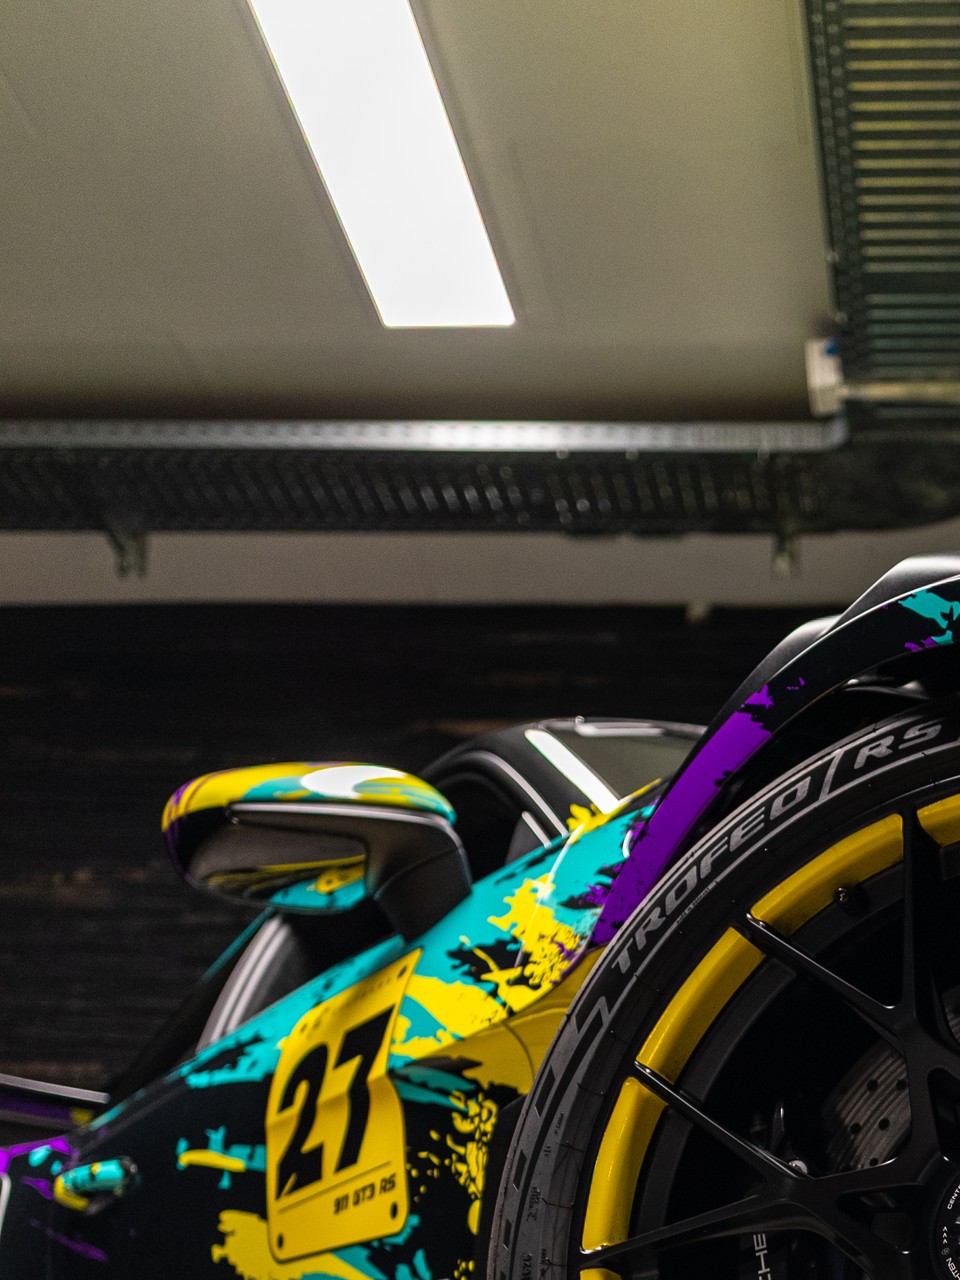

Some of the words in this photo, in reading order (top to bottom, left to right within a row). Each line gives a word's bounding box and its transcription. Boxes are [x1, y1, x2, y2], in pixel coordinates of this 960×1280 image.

[612, 776, 811, 974] TROFEO
[854, 723, 942, 769] RS
[276, 1003, 396, 1201] 27
[379, 1172, 397, 1195] RS
